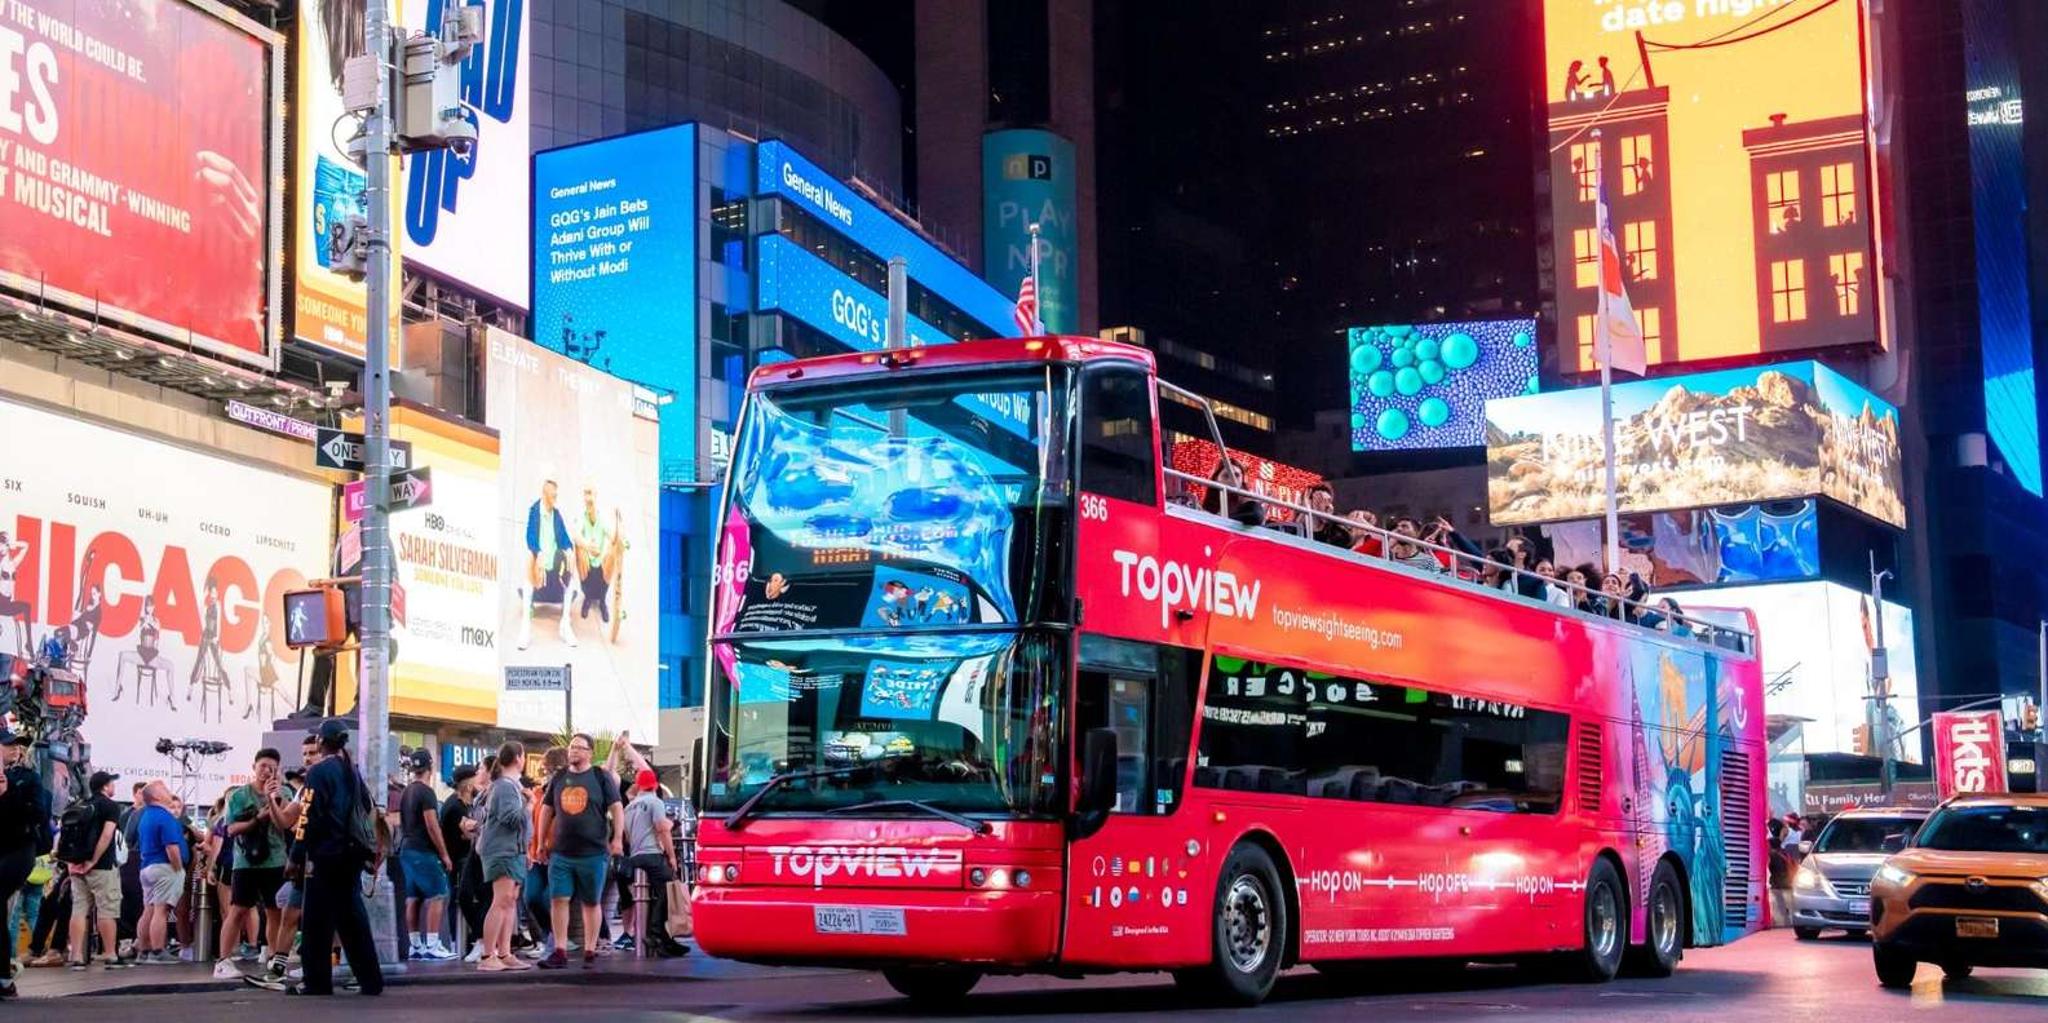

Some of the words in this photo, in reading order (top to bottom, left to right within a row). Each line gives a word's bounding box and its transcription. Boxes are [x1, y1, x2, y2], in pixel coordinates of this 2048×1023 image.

[1602, 7, 1686, 32] date
[1694, 0, 1797, 18] nig
[10, 1, 35, 31] THE
[37, 12, 83, 53] WORLD
[86, 36, 126, 73] COULD
[127, 55, 147, 83] BE.
[15, 144, 46, 176] AND
[551, 182, 588, 199] General
[589, 177, 616, 194] News
[782, 162, 825, 207] General
[824, 190, 852, 227] News
[15, 169, 112, 237] MUSICAL
[551, 209, 590, 228] GQG's
[593, 205, 616, 221] Jain
[620, 199, 648, 215] Bets
[551, 229, 584, 247] Adani
[587, 224, 625, 241] Group
[628, 216, 650, 232] Will
[551, 250, 586, 265] Thrive
[589, 243, 615, 258] With
[619, 241, 633, 252] or
[551, 267, 597, 284] Without
[599, 259, 629, 274] Modi
[298, 297, 347, 335] SOMEONE
[351, 315, 366, 333] YO
[831, 289, 880, 341] GQG's
[1644, 405, 1753, 451] WEST
[332, 443, 358, 461] ONE
[5, 479, 22, 491] SIX
[393, 483, 418, 501] WAY
[67, 492, 106, 510] SQUISH
[1081, 496, 1108, 522] 366
[138, 508, 168, 523] UH-UH
[199, 521, 231, 537] CICERO
[425, 512, 445, 531] HBO
[255, 534, 296, 551] LIPSCHITZ
[400, 532, 436, 568] SARAH
[438, 542, 497, 581] SILVERMAN
[461, 625, 495, 648] max
[1272, 606, 1404, 650] topviewsightseeing.com
[1952, 713, 1991, 793] tkts
[1823, 793, 1861, 806] Family
[1312, 871, 1340, 903] HOP
[1342, 873, 1362, 891] ON
[1418, 872, 1444, 903] HOP
[1446, 874, 1469, 893] OFF
[1516, 876, 1538, 904] HOP
[1539, 878, 1553, 894] ON
